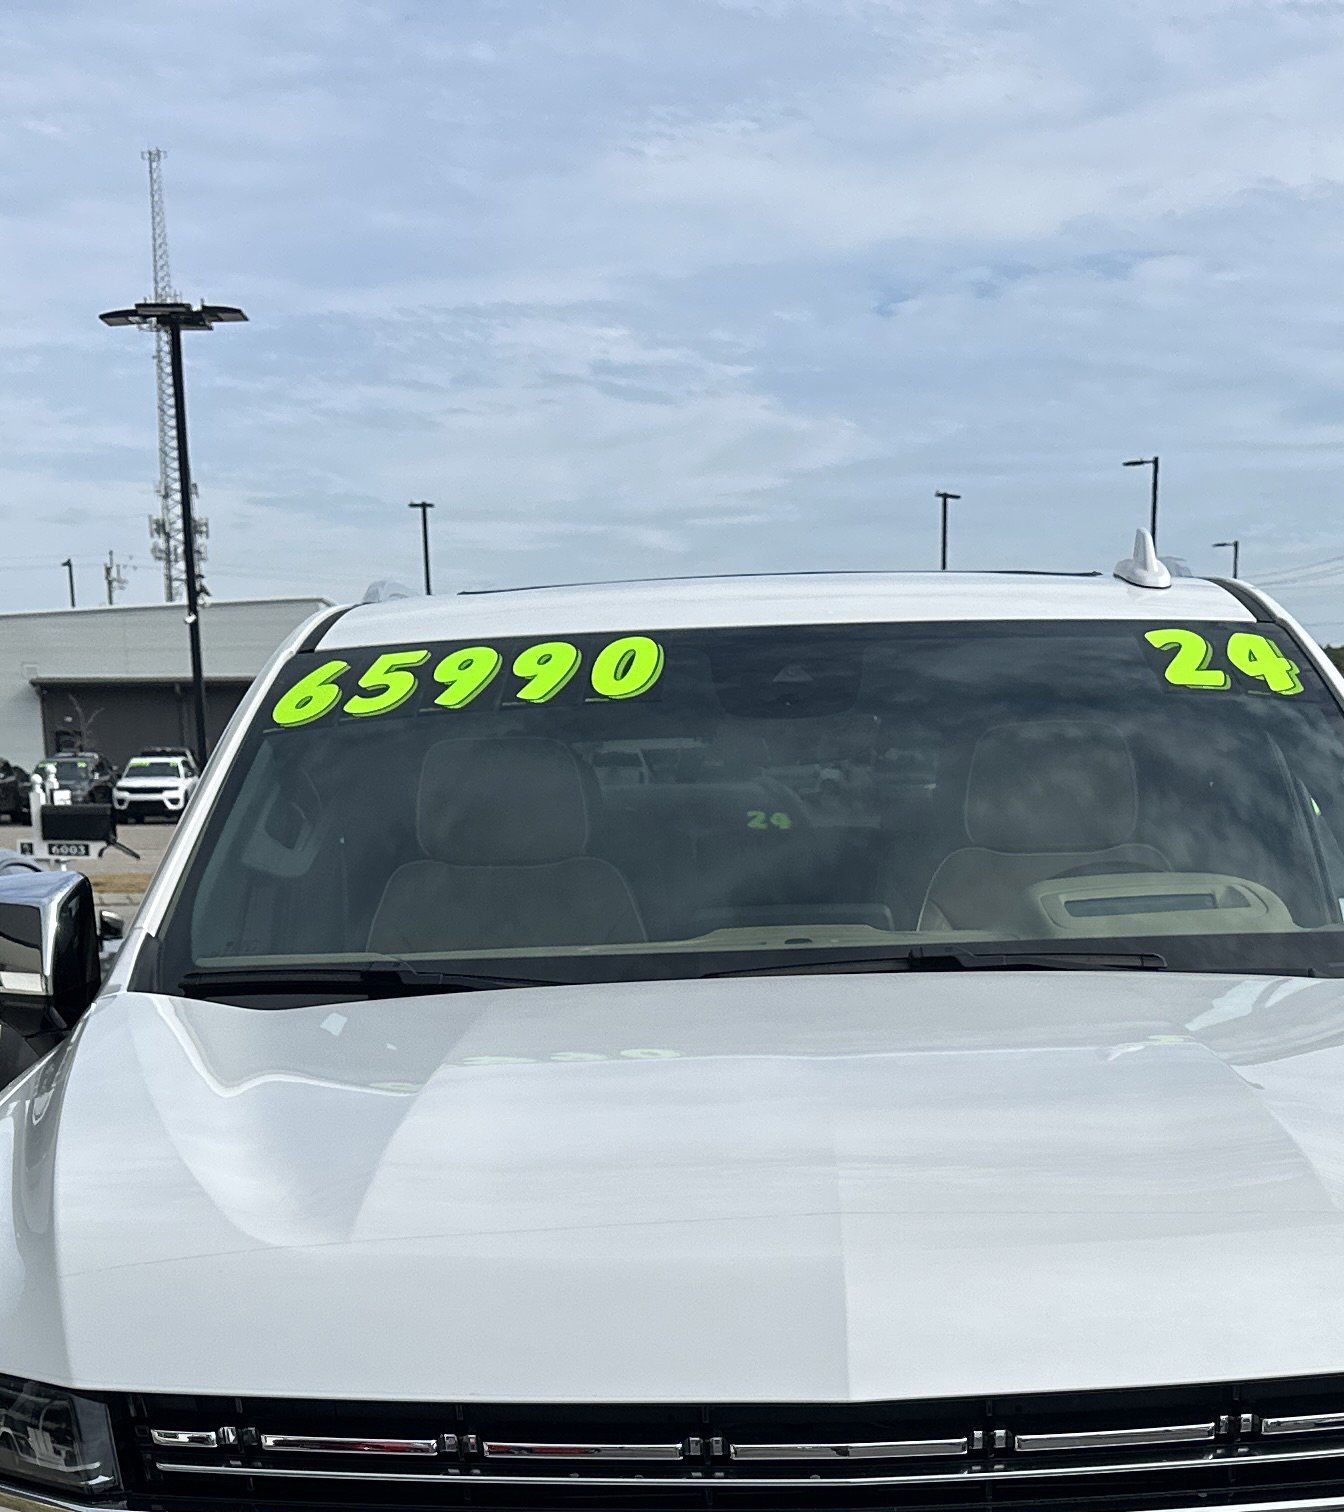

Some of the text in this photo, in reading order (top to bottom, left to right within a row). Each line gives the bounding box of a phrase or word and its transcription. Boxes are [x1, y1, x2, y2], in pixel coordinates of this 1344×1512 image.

[272, 636, 666, 728] 65990
[1144, 629, 1304, 696] 24
[51, 844, 86, 855] 6003
